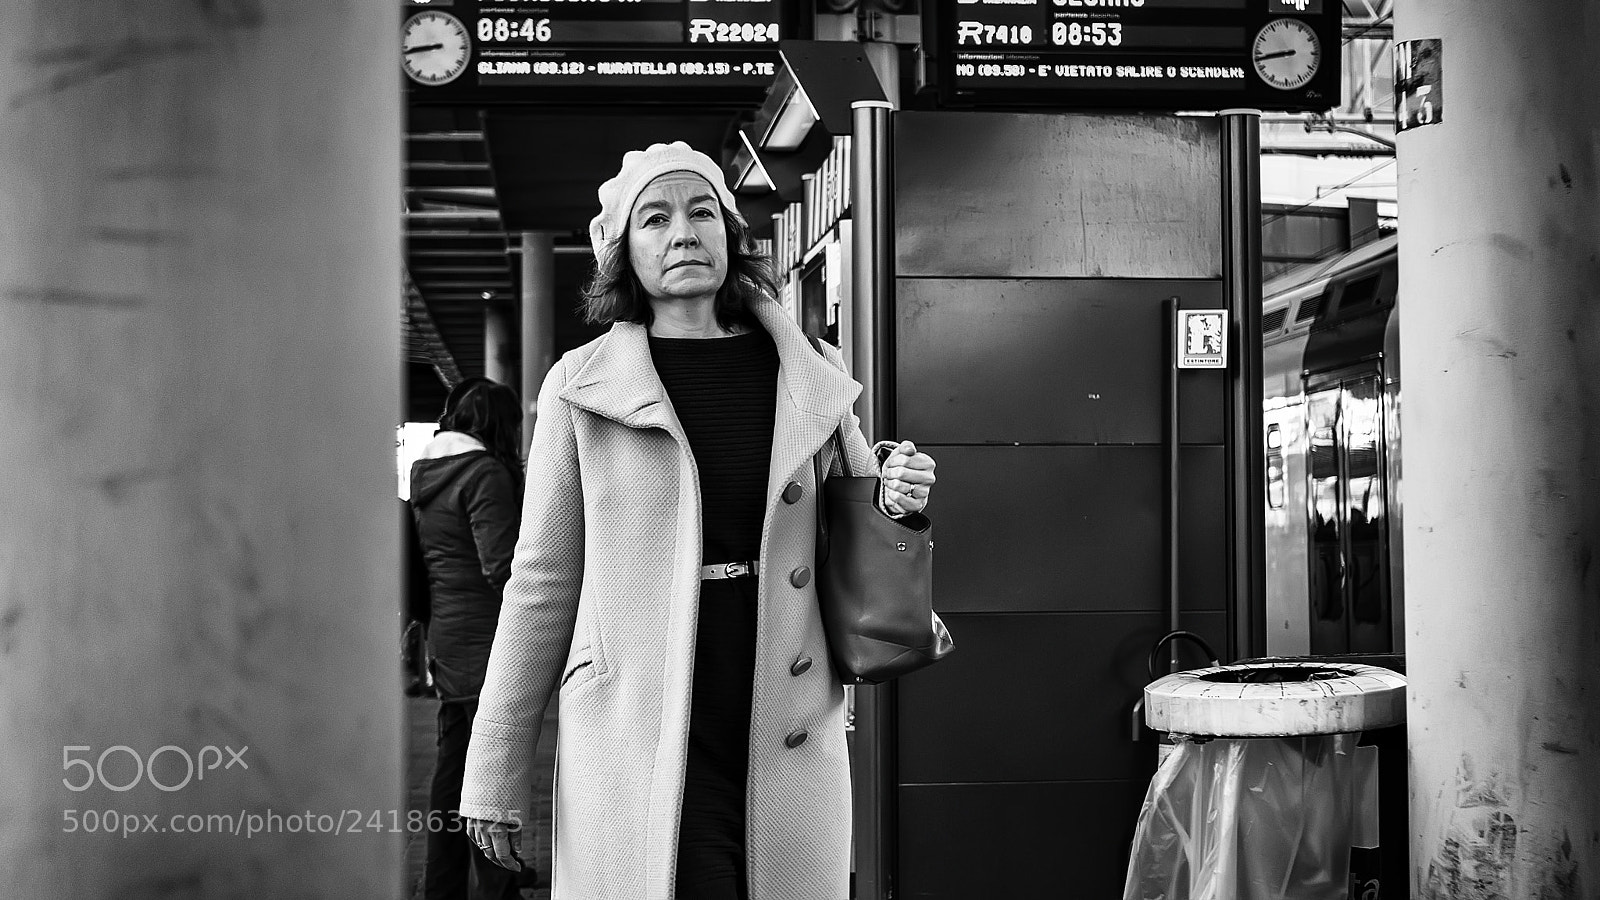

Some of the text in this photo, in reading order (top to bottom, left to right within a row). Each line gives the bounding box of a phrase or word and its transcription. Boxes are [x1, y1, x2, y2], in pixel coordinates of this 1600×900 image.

[477, 18, 552, 42] 08:46
[1052, 22, 1121, 46] 08:53
[742, 62, 775, 76] P.TE
[1054, 65, 1113, 78] VIETATO
[1115, 66, 1164, 78] SALIRE
[1166, 66, 1177, 78] O
